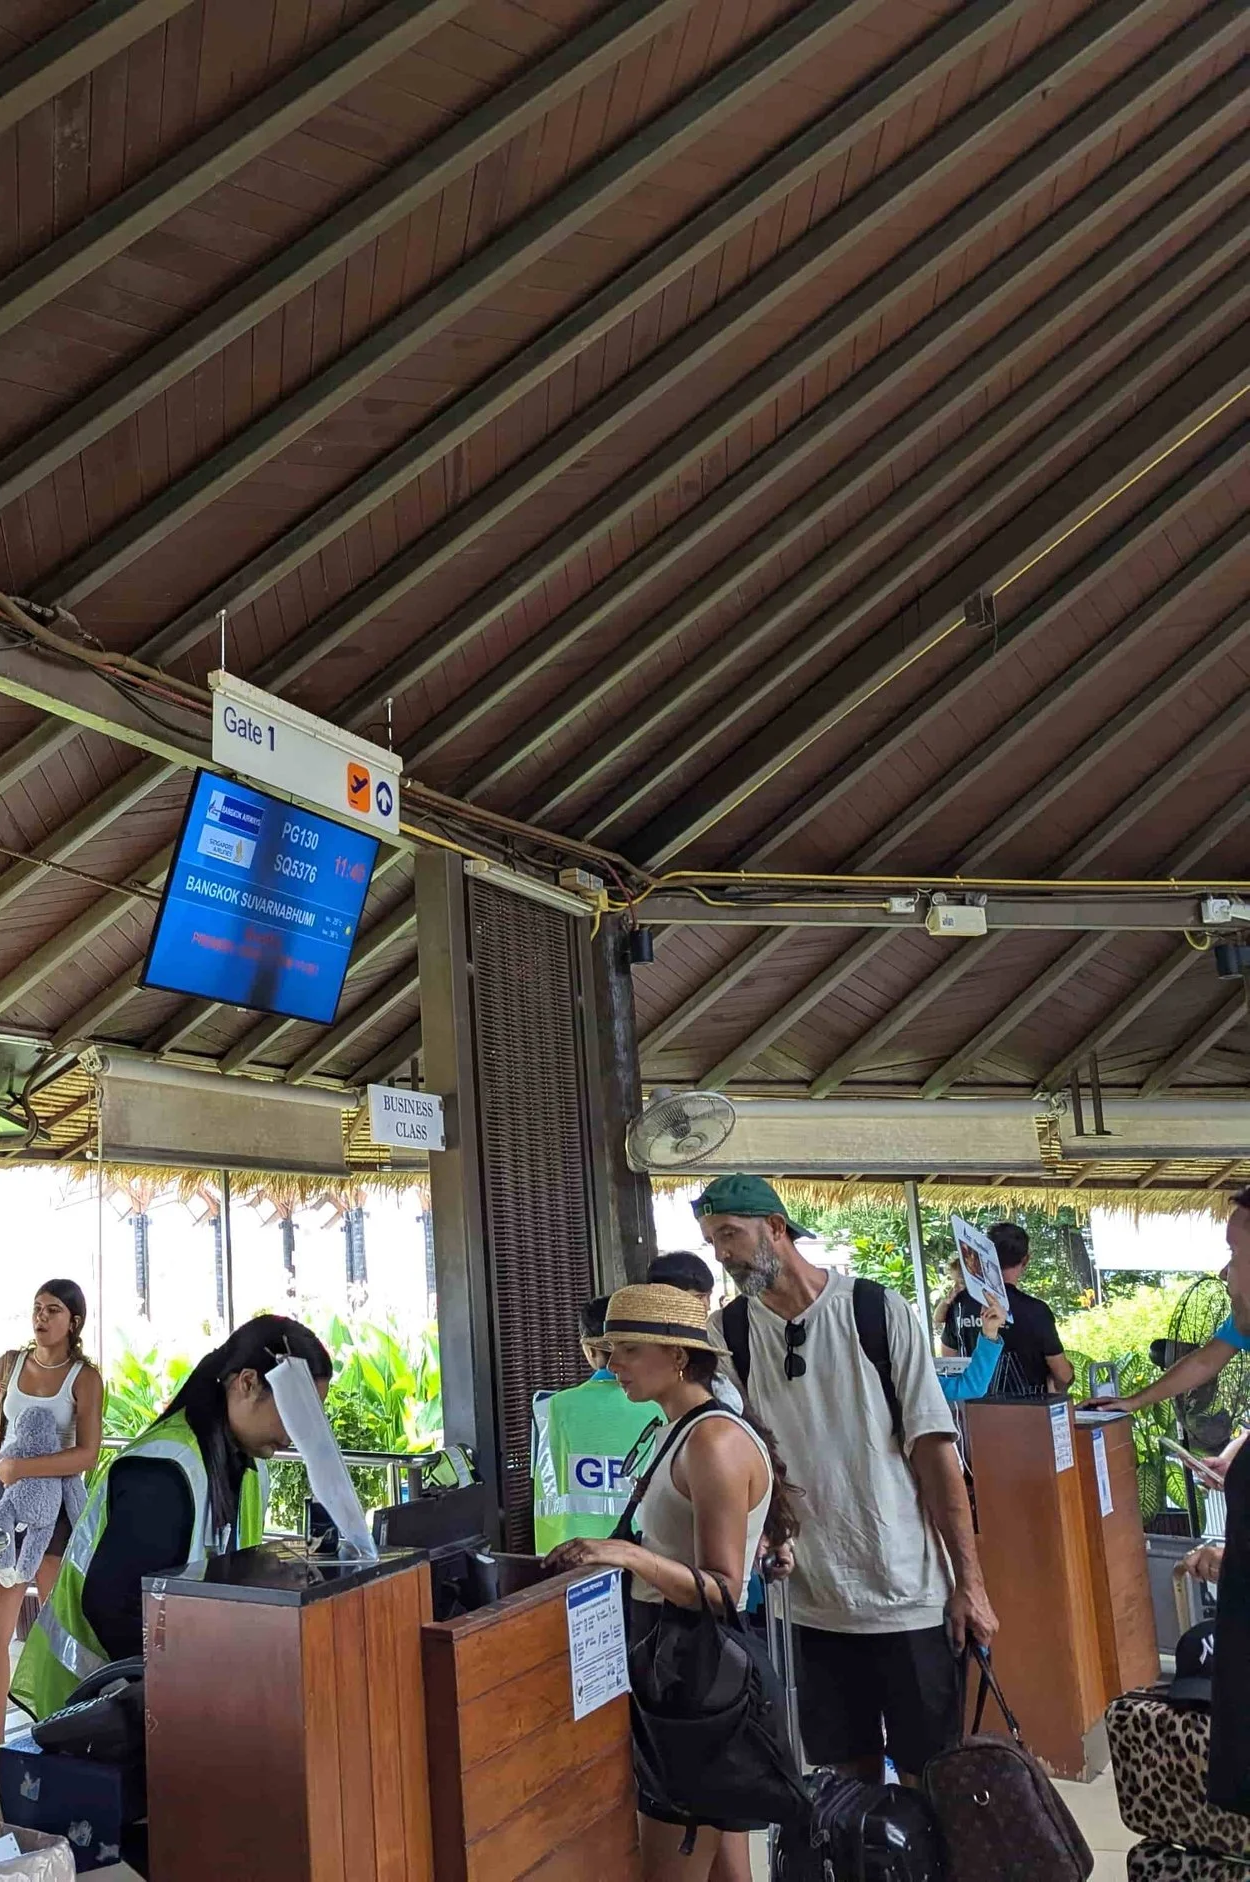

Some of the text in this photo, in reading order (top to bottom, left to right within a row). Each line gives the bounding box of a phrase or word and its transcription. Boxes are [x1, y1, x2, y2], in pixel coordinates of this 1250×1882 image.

[224, 706, 275, 752] Gate 1
[281, 822, 319, 850] PG130
[273, 854, 318, 883] SQ5376
[185, 875, 316, 927] BANGKOK SUVARNABHUMI
[383, 1095, 434, 1117] BUSINESS
[395, 1121, 428, 1140] CLASS
